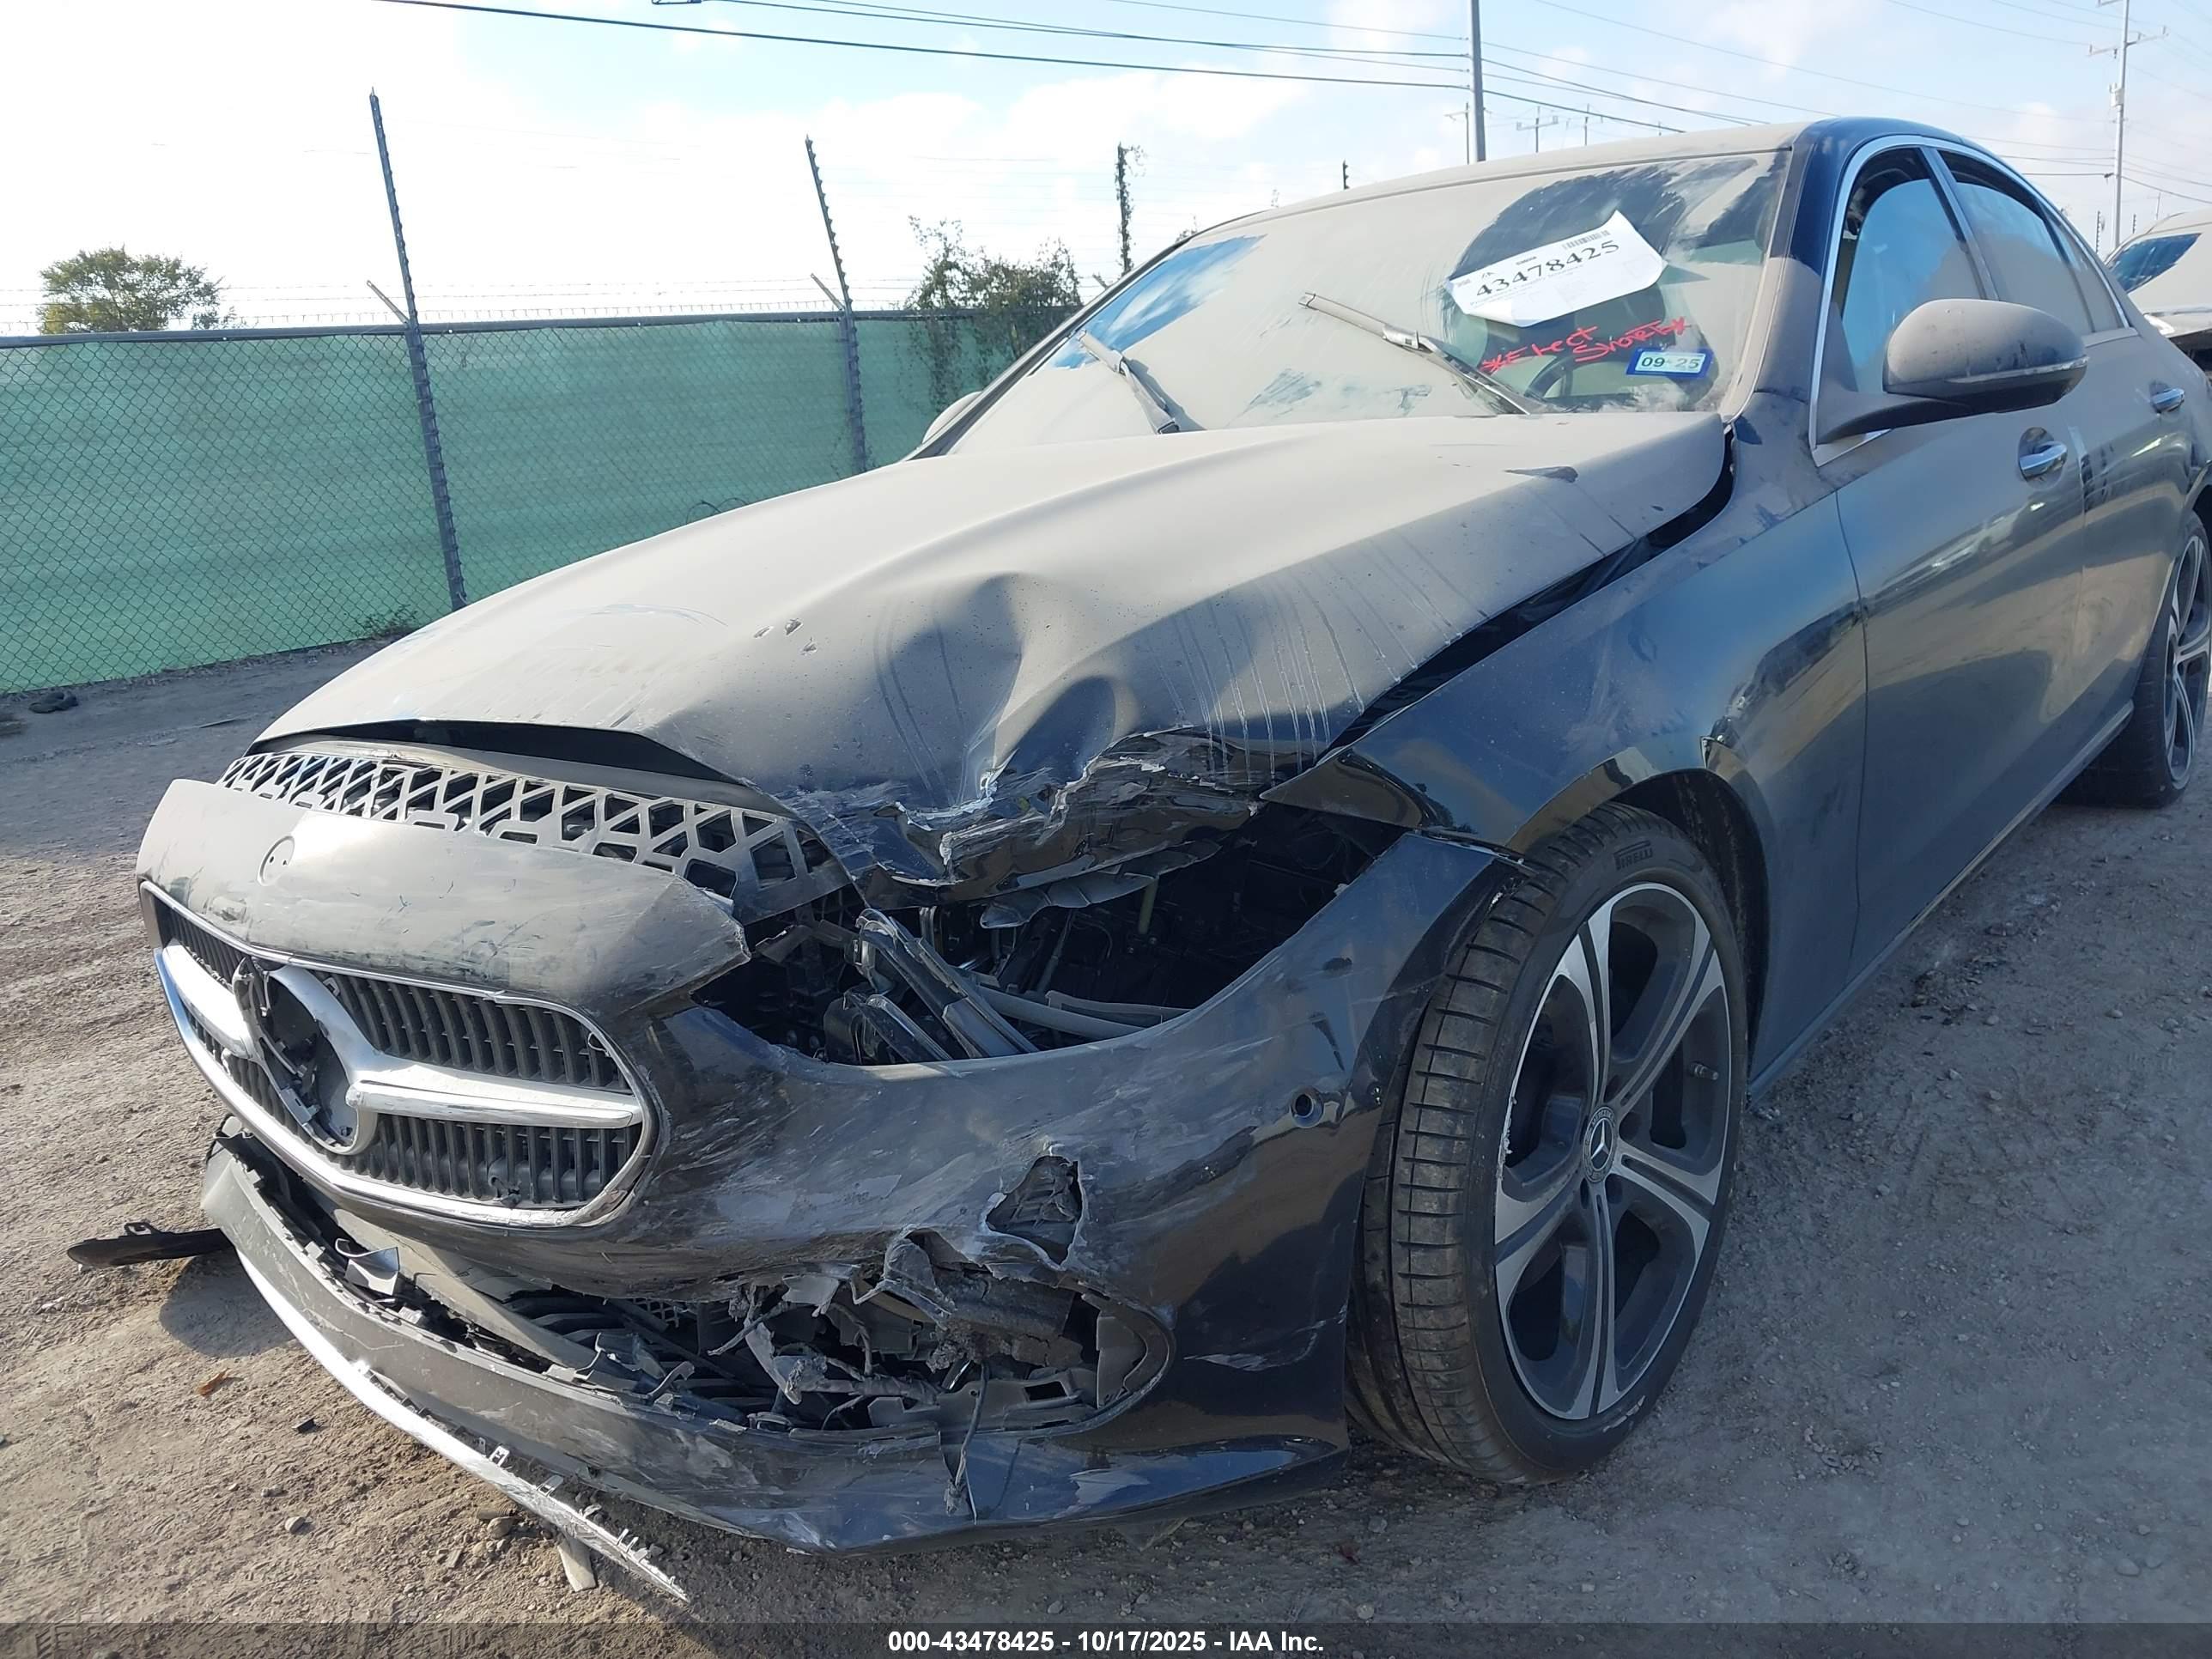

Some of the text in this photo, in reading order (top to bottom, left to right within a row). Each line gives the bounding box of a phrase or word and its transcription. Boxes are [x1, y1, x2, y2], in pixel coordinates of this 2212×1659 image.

[1476, 240, 1620, 296] 43478425
[1641, 356, 1700, 369] 09 25
[1613, 840, 1653, 871] PIRELLI
